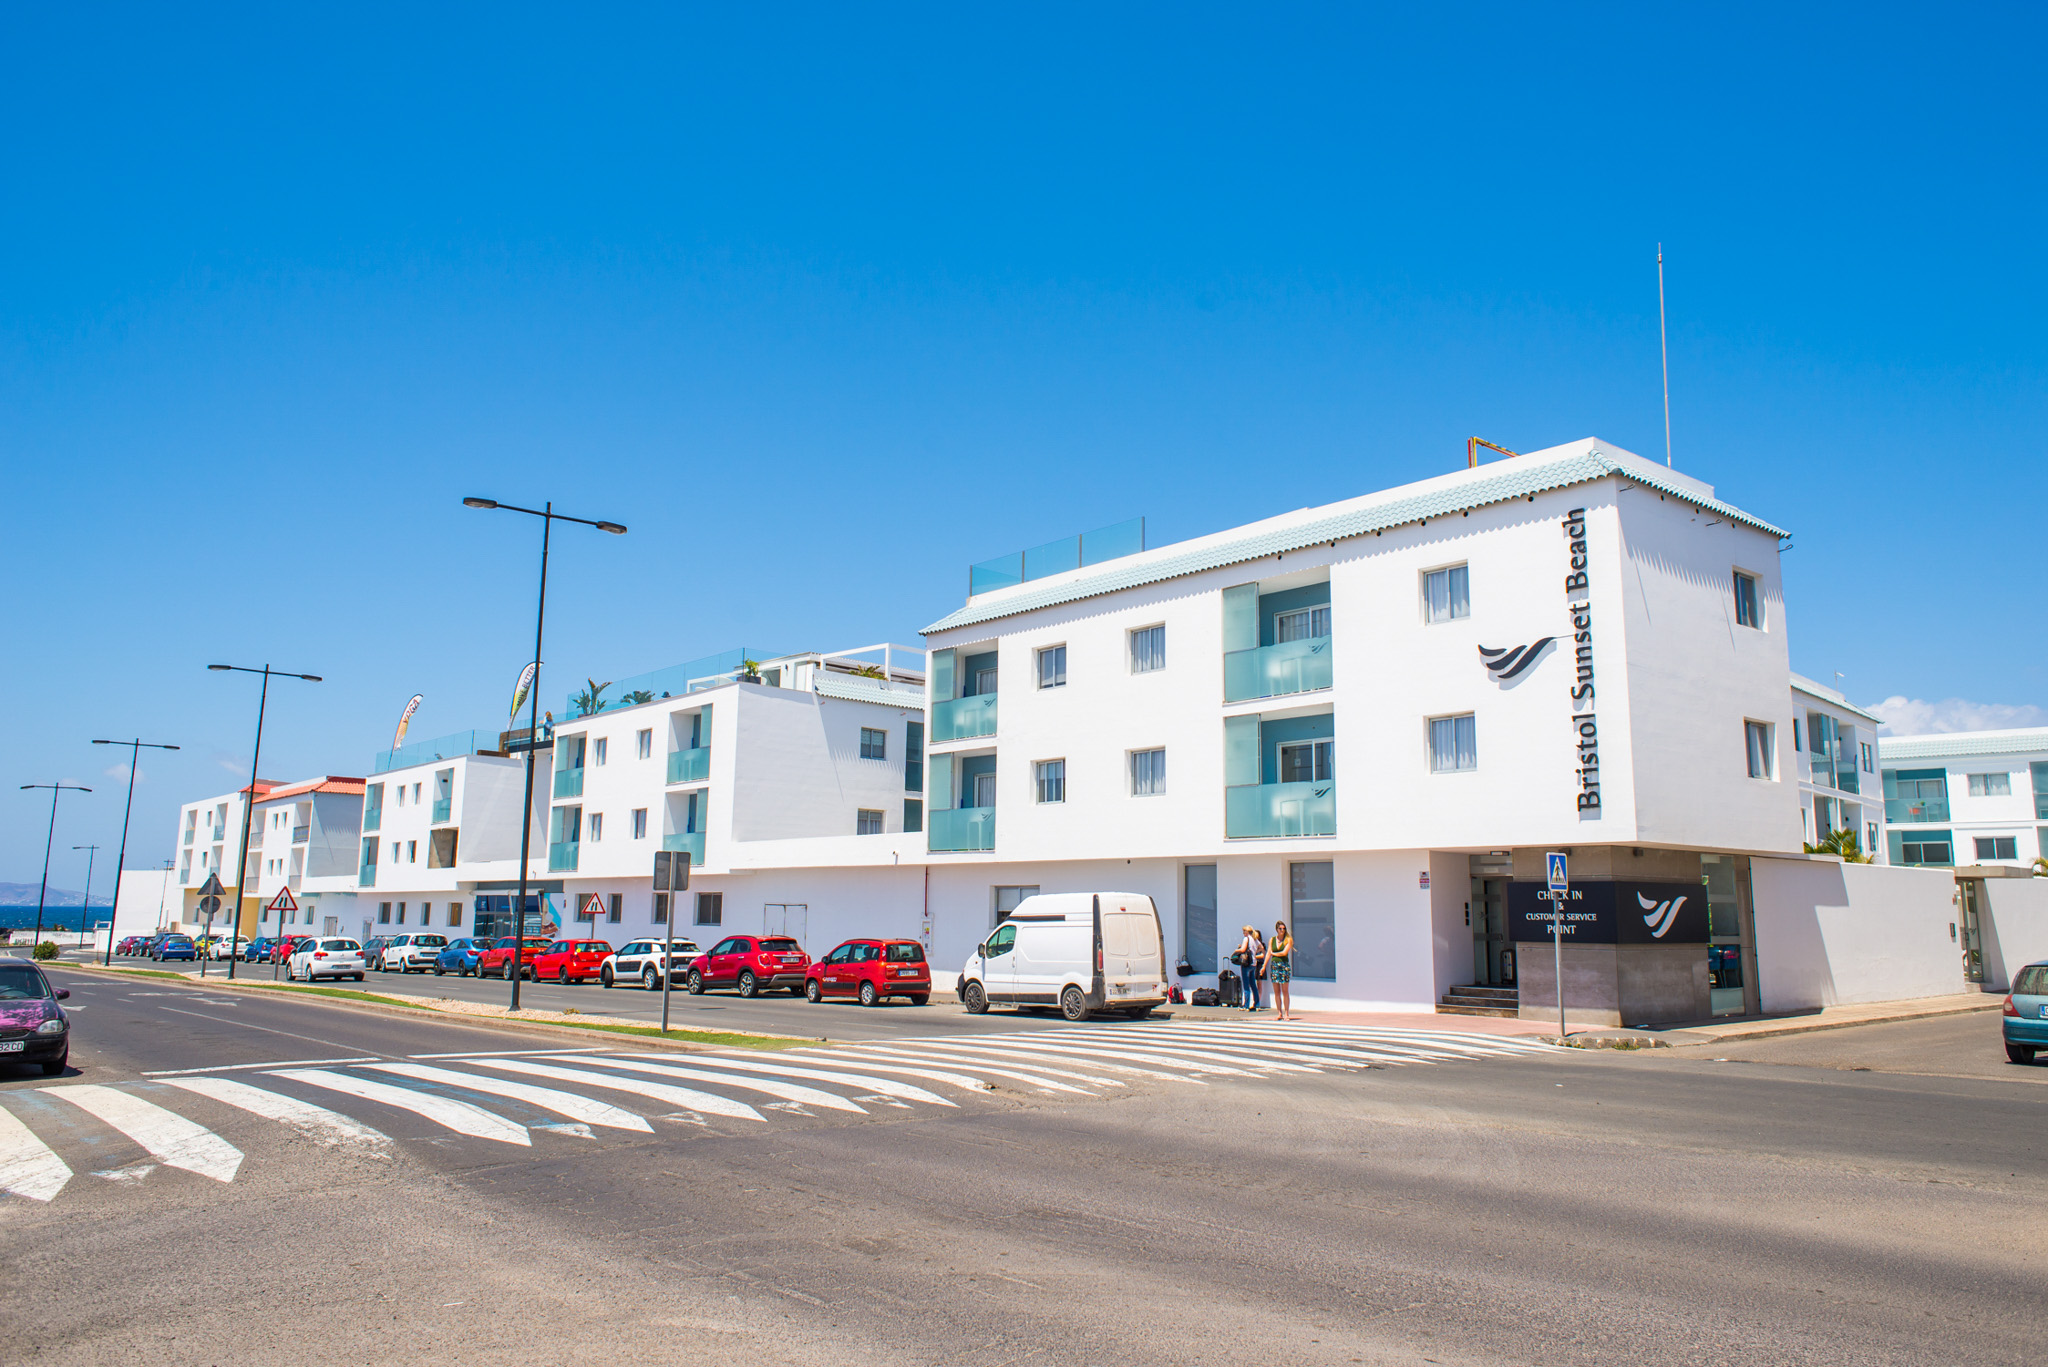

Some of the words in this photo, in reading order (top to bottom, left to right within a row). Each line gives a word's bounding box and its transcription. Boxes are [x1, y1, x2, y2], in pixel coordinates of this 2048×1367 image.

[1562, 507, 1589, 594] Beach
[1570, 602, 1595, 701] Sunset
[522, 665, 536, 689] BETTER
[403, 699, 420, 723] YOGA
[1572, 713, 1600, 813] Bristol
[1557, 901, 1565, 911] &
[1571, 890, 1583, 900] IN
[1525, 913, 1565, 921] CUSTOMR
[1566, 913, 1598, 921] SERVICE
